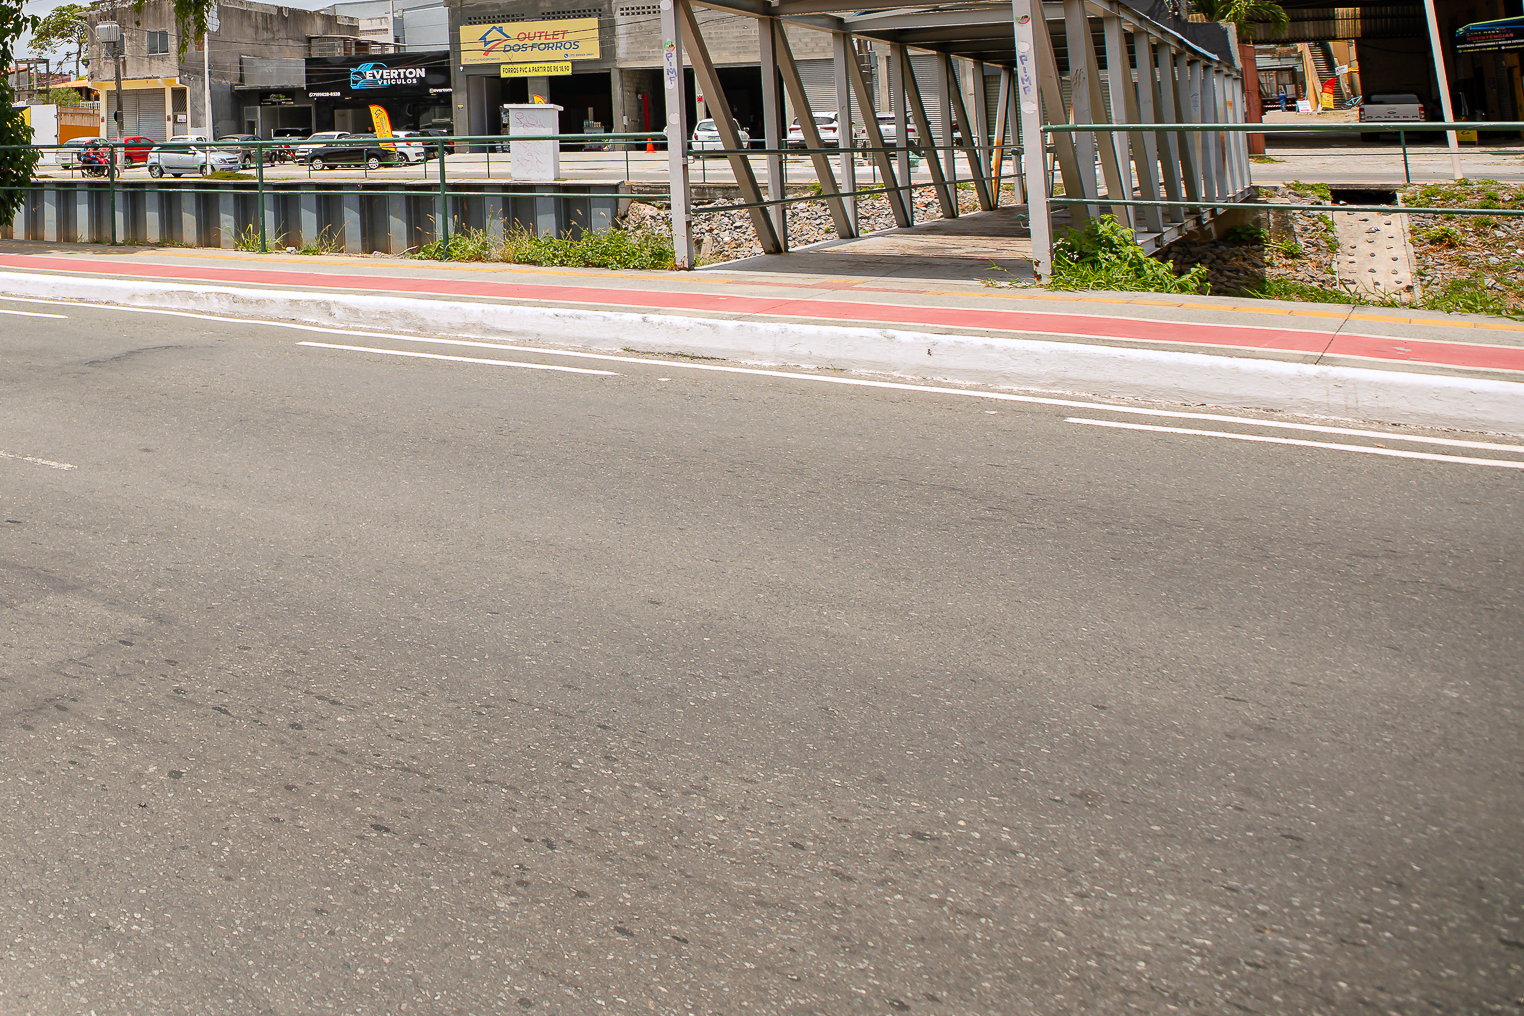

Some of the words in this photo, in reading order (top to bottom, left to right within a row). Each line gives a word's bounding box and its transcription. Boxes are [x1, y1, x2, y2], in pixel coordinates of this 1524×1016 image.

[517, 30, 568, 41] OUTLET
[503, 44, 528, 53] DOS
[530, 41, 580, 51] FORROS
[366, 68, 425, 80] EVERTON
